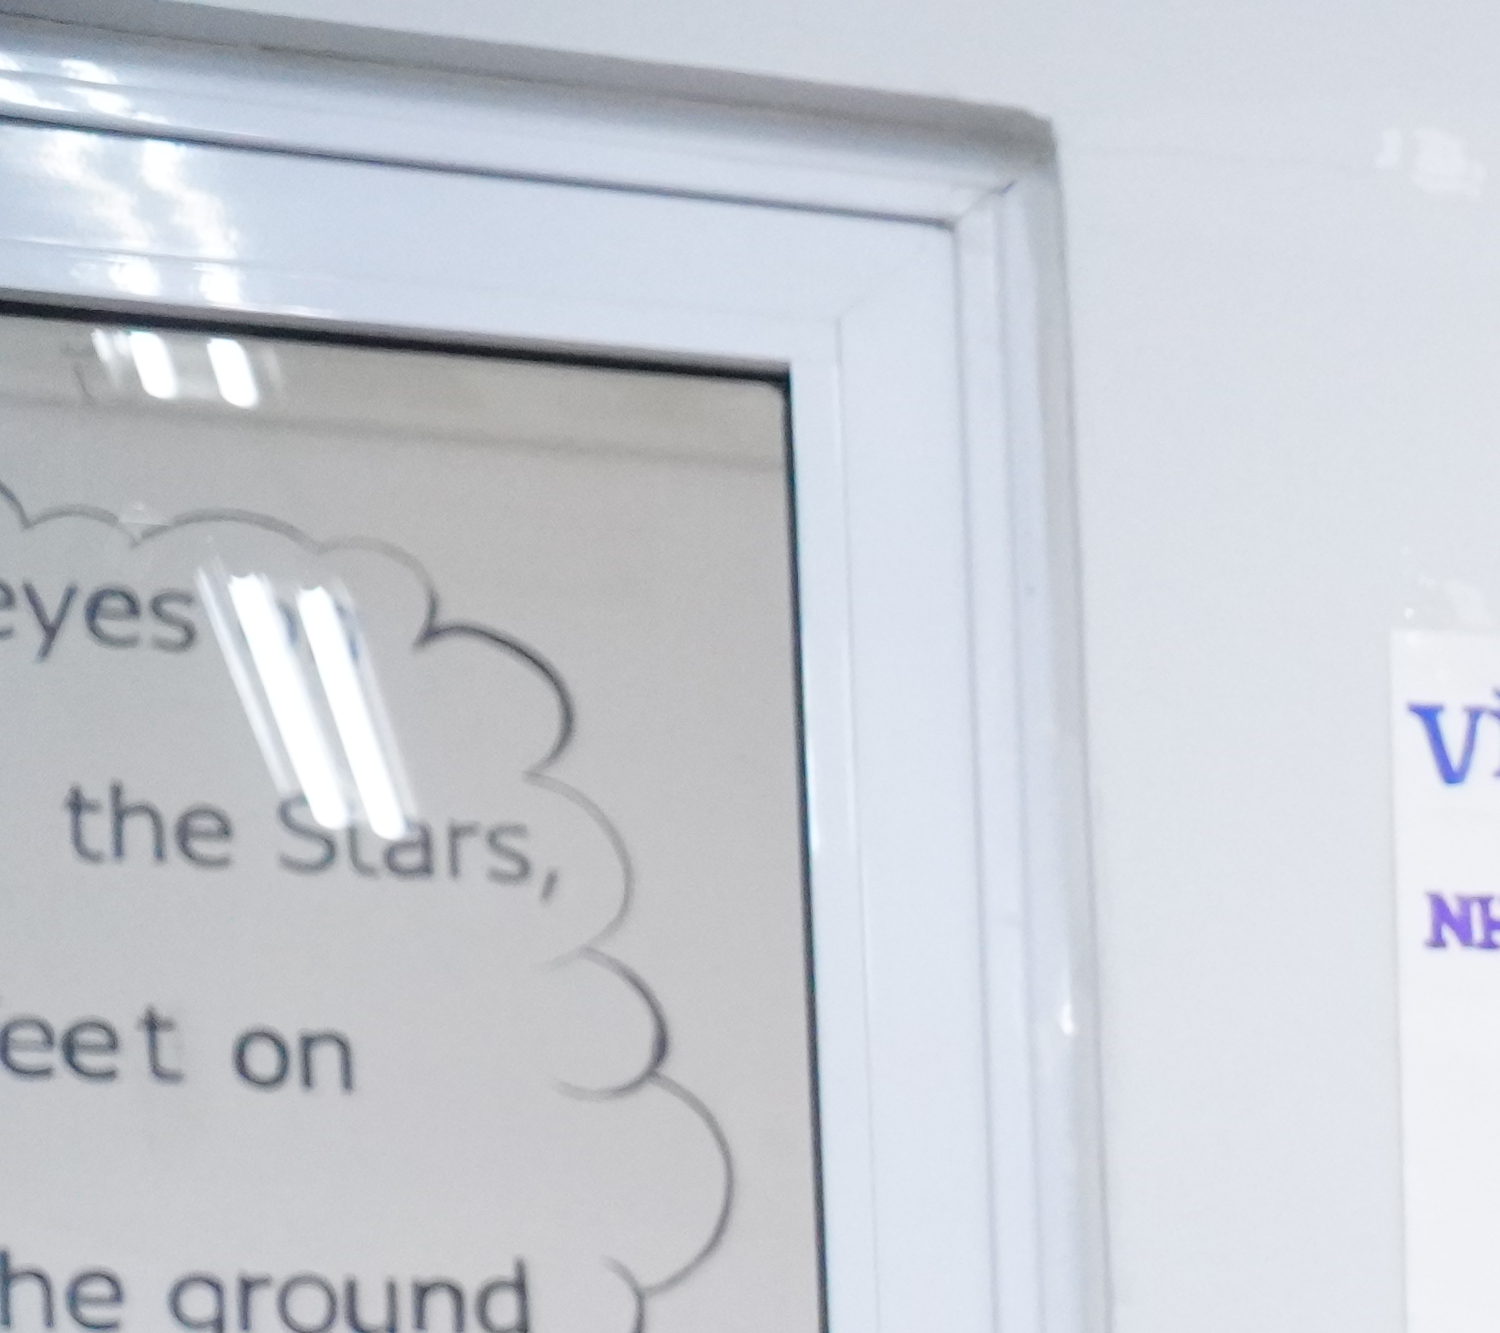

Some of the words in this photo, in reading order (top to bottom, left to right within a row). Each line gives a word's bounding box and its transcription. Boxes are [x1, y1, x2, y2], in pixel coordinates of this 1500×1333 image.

[64, 783, 233, 866] the
[0, 1004, 184, 1083] eet
[233, 1026, 353, 1095] on
